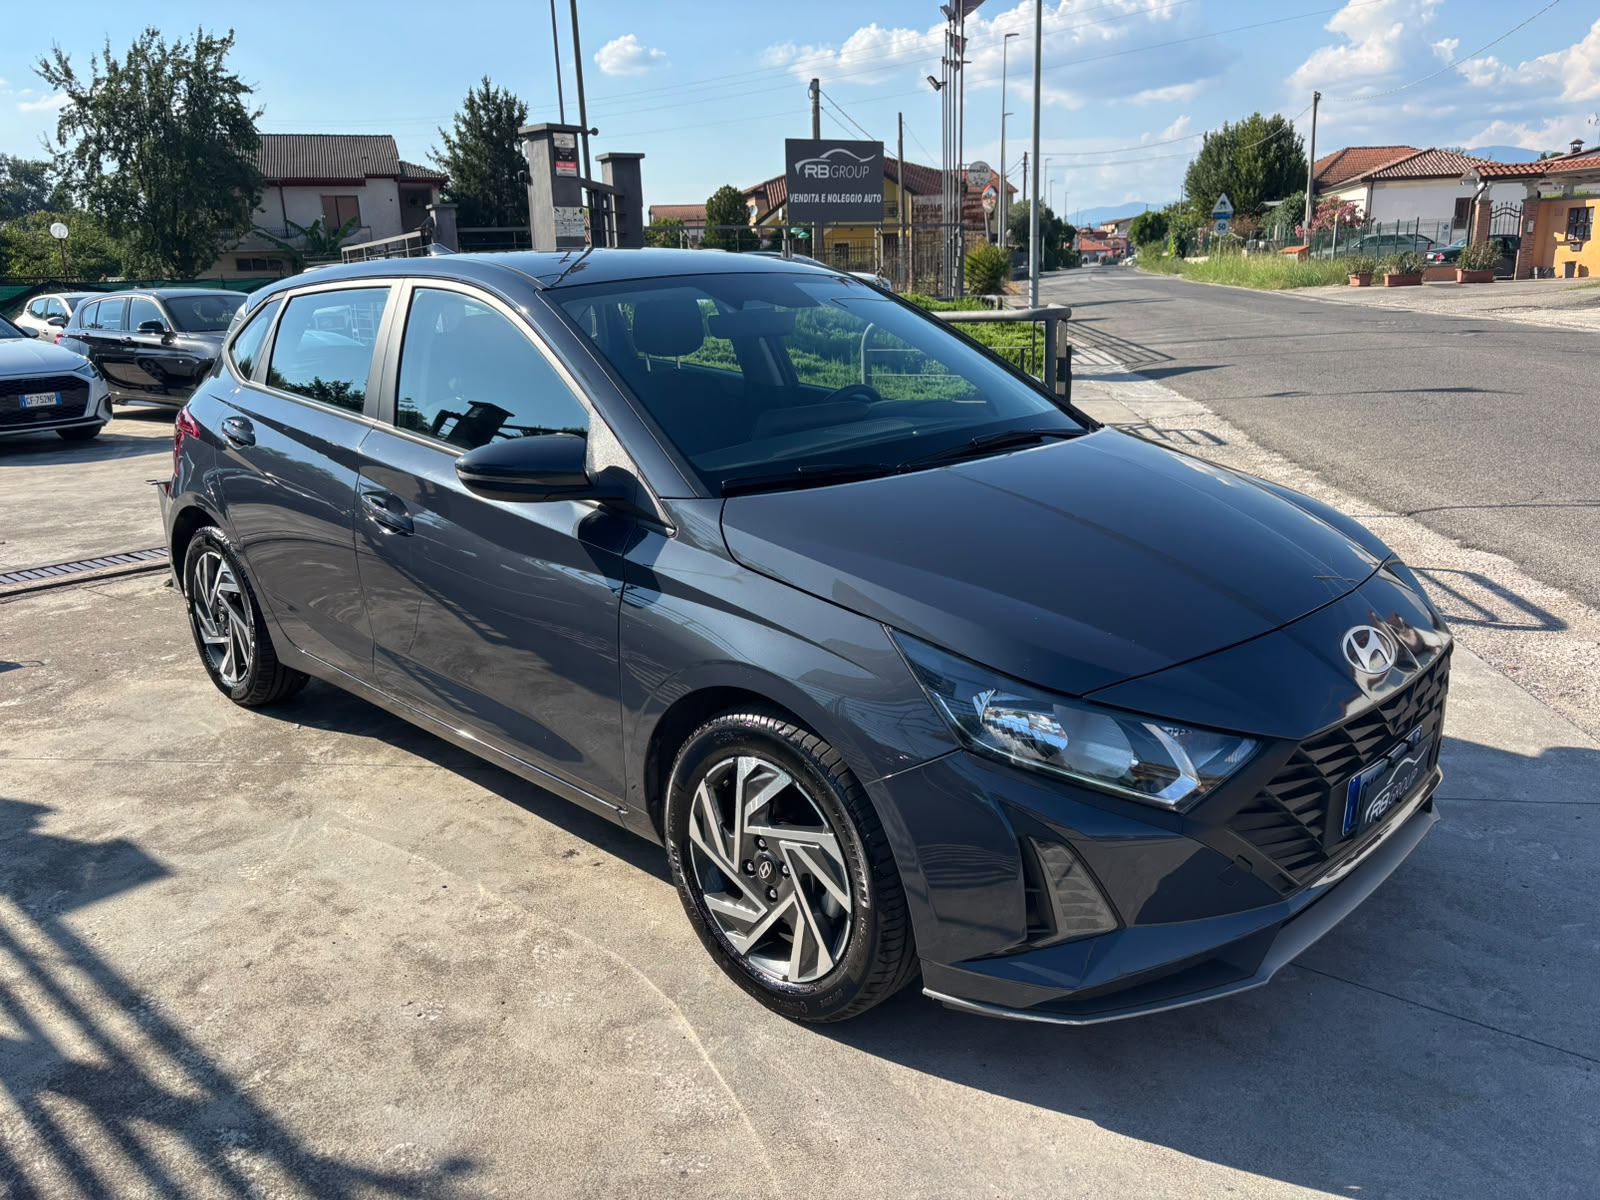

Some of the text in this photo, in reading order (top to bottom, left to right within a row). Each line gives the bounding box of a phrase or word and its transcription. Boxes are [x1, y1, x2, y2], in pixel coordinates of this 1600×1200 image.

[789, 193, 882, 203] VENDITA E NOLEGGIO AUTO
[1217, 223, 1227, 231] 50
